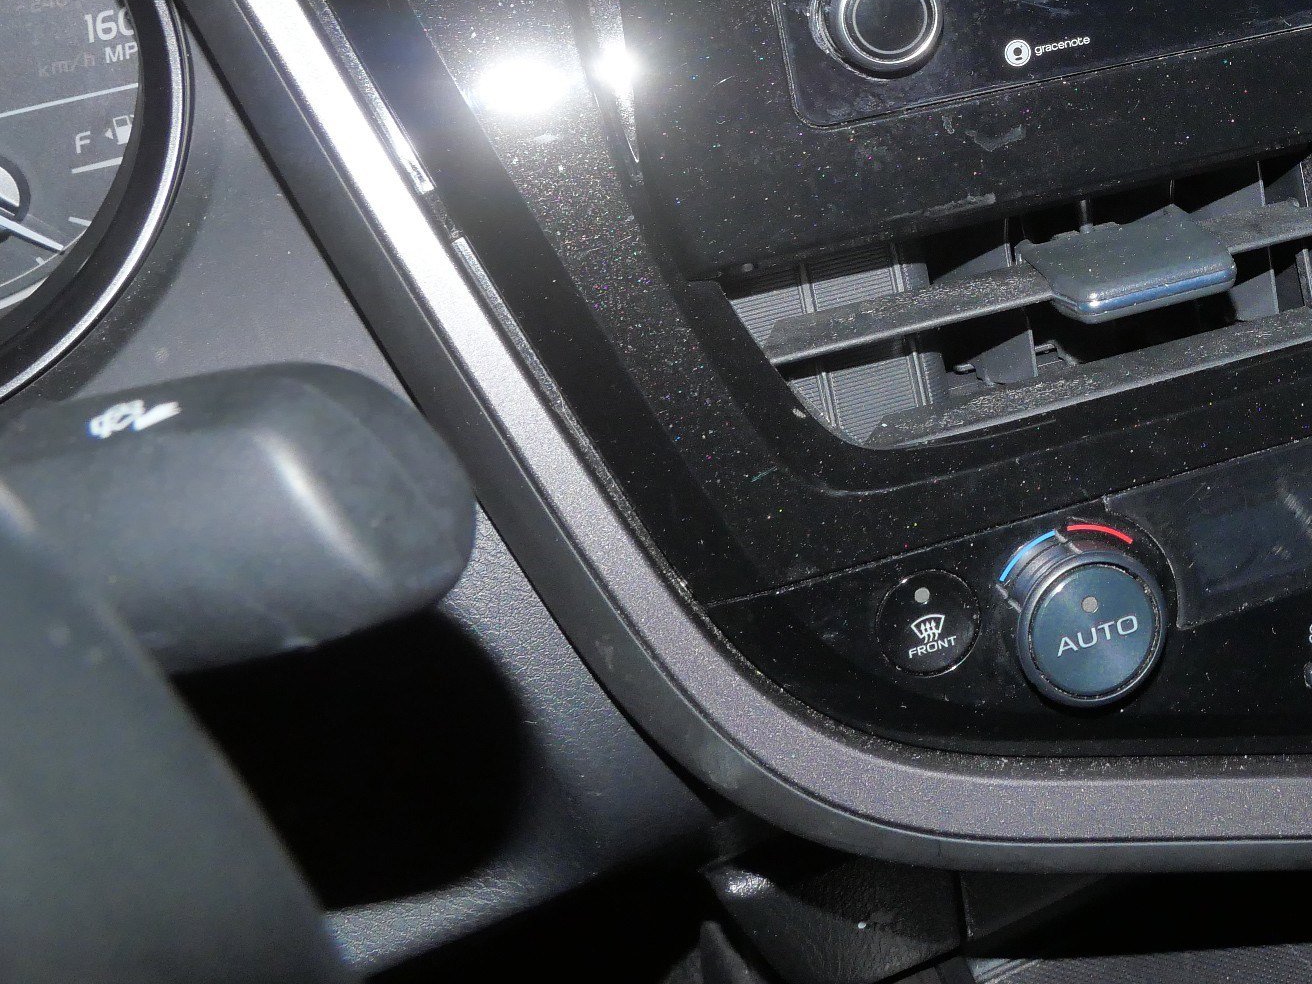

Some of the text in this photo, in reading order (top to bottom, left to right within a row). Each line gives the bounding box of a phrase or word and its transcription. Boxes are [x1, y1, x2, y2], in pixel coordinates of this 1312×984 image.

[1034, 36, 1091, 56] gracenote
[75, 130, 91, 154] F
[908, 635, 957, 659] FRONT
[1056, 615, 1138, 658] AUTO
